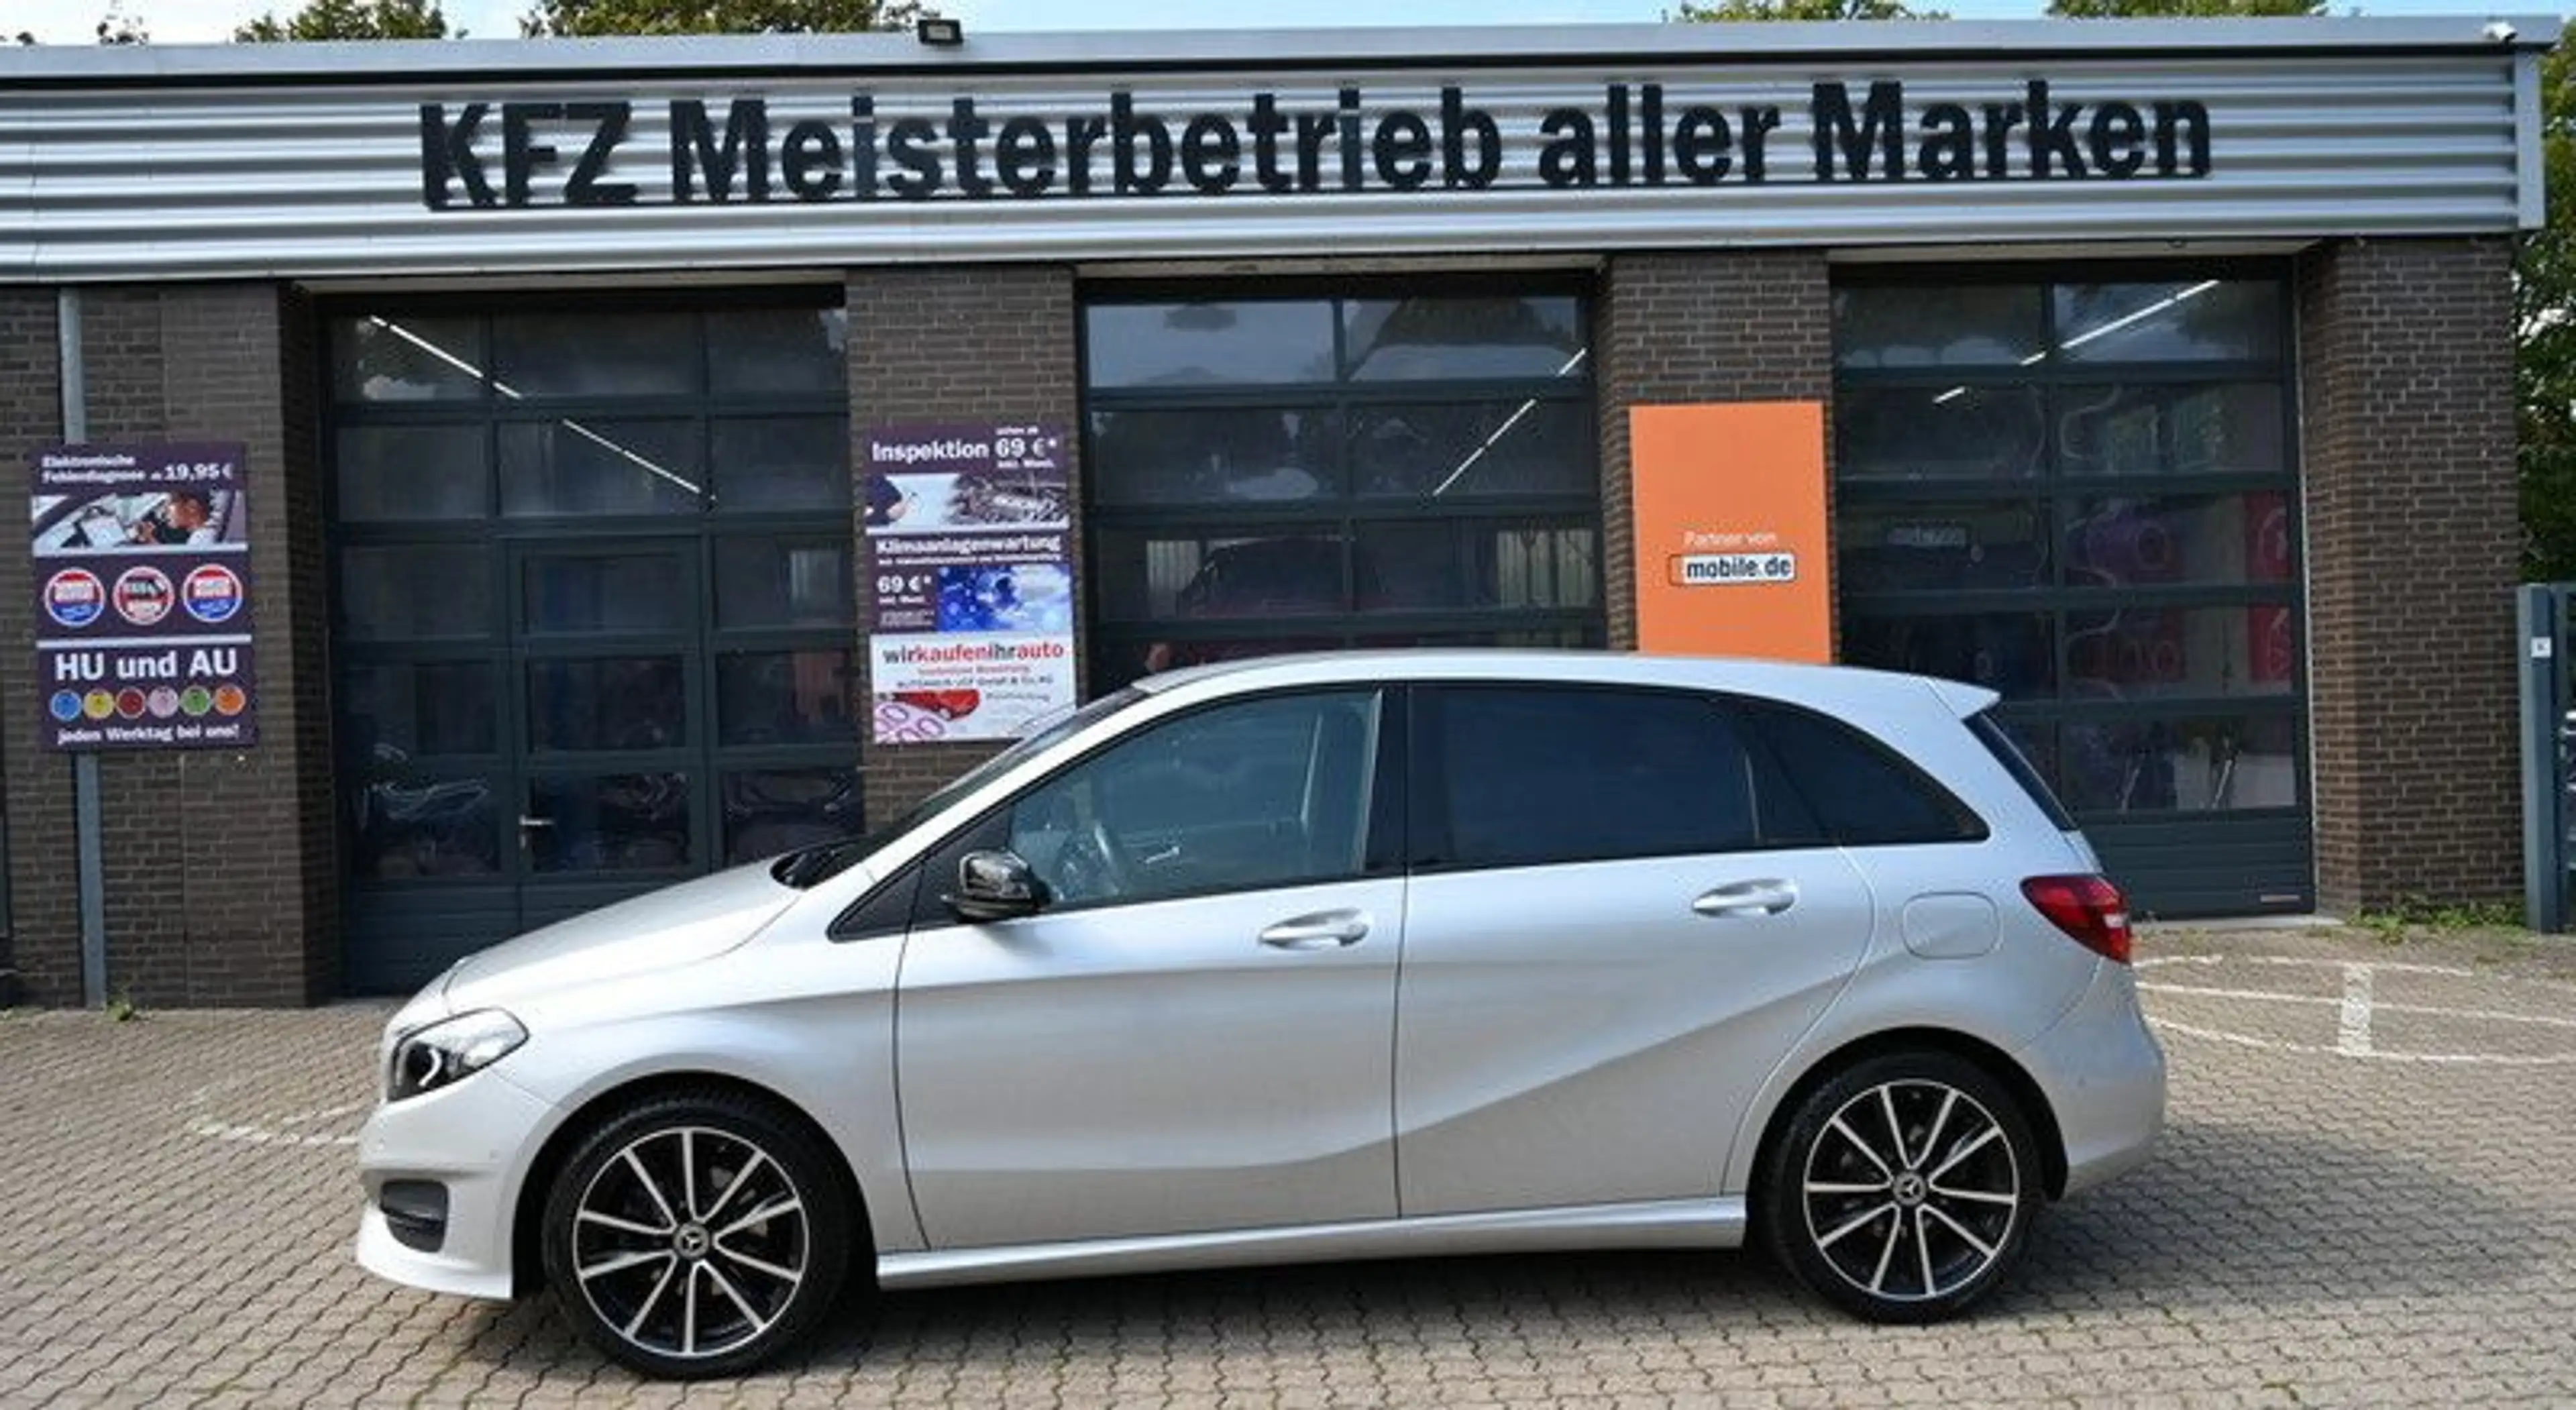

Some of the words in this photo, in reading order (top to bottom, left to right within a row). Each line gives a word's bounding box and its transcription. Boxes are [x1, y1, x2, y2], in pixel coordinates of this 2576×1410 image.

[419, 100, 637, 210] KFZ
[670, 85, 1501, 203] Meisterbetrieb
[1538, 82, 1780, 187] aller
[1811, 78, 2212, 182] Marken
[871, 438, 989, 464] Inspektion
[995, 437, 1026, 457] 69
[164, 463, 220, 482] 19,95
[1686, 555, 1792, 578] mobile.de
[877, 575, 904, 593] 69
[882, 641, 1064, 663] wirkaufenihrauto
[56, 653, 104, 680] HU
[117, 653, 177, 677] und
[189, 649, 237, 675] AU
[58, 728, 101, 745] jeden
[105, 726, 174, 742] Werktag
[177, 724, 201, 738] bei
